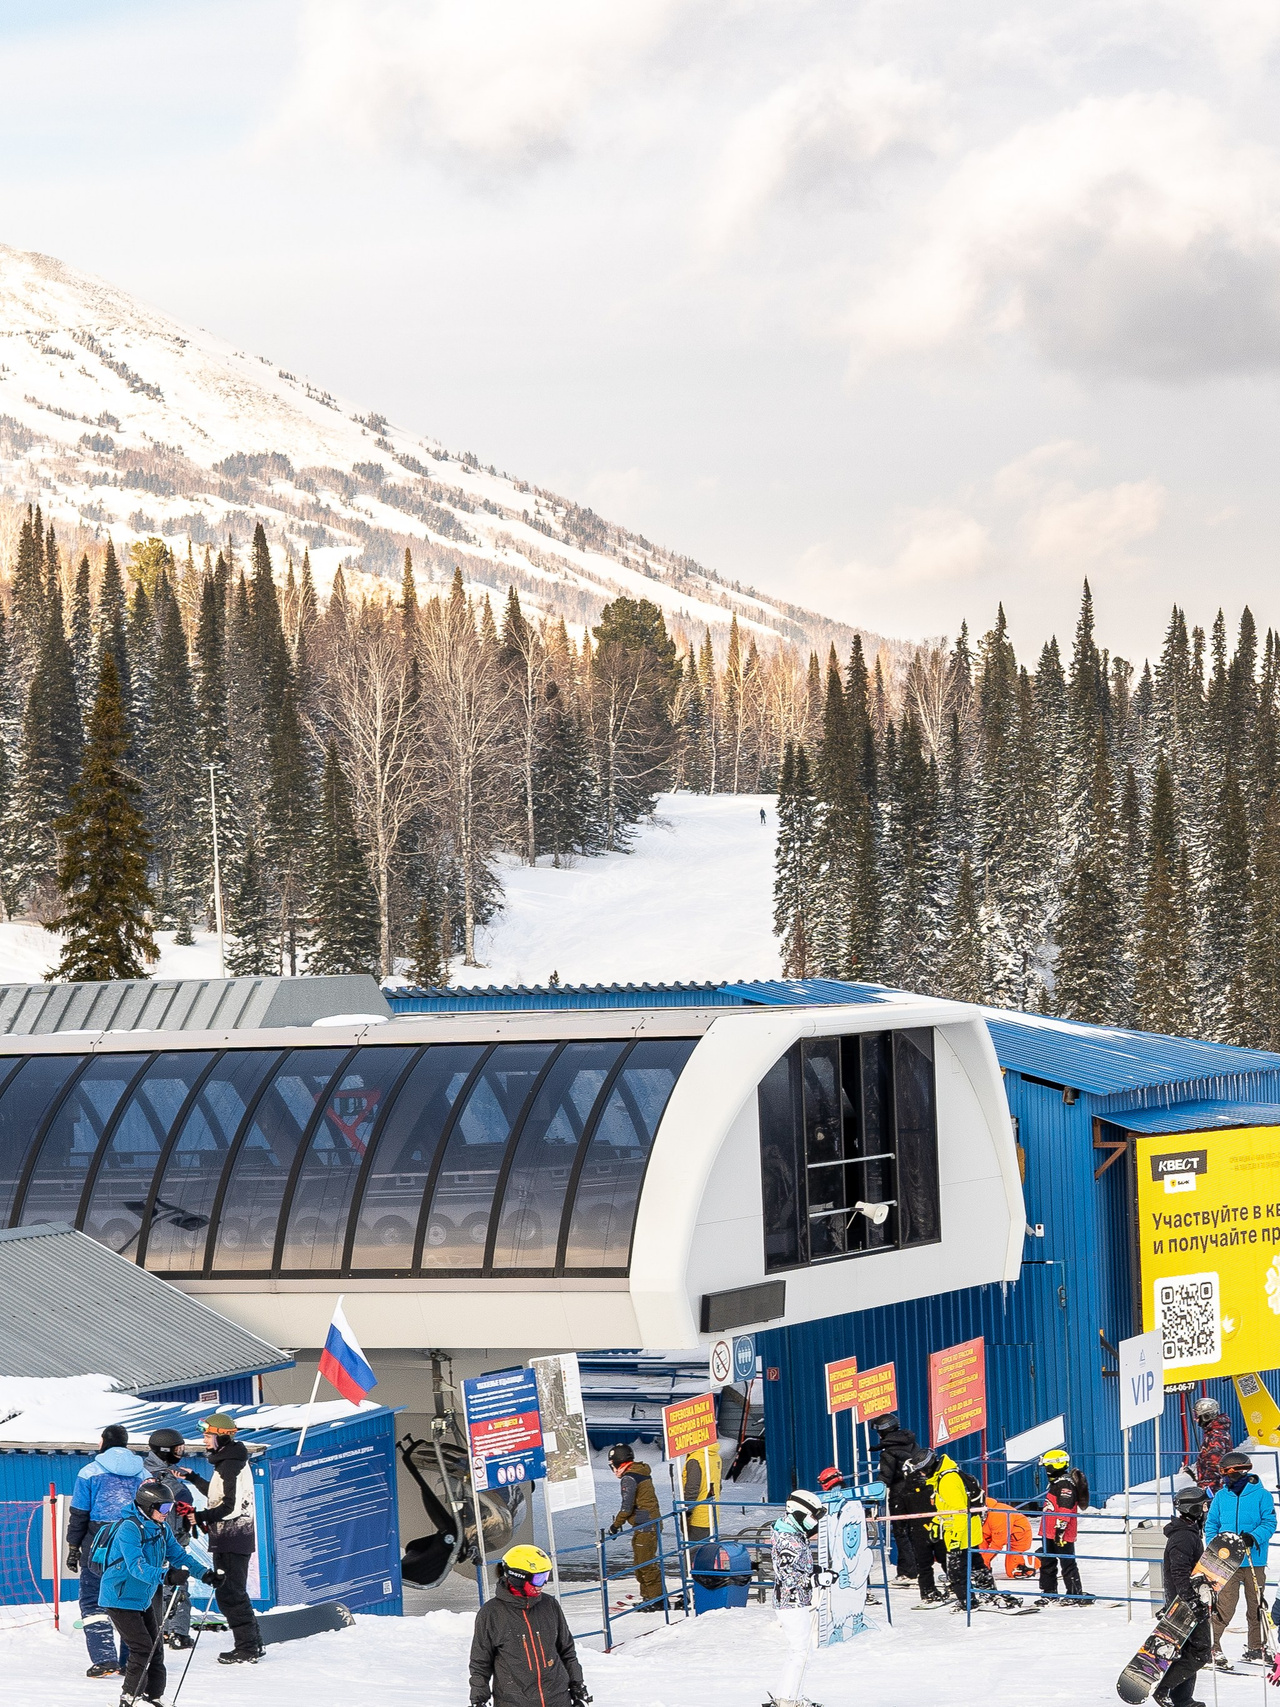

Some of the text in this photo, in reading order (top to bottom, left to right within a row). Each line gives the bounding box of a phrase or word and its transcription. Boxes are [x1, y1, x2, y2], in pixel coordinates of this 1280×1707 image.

[1158, 1158, 1199, 1172] КВЕСТ
[1152, 1204, 1249, 1230] Участвуйте
[1253, 1206, 1262, 1219] в
[1154, 1240, 1164, 1255] и
[1168, 1228, 1257, 1254] получайте
[1132, 1370, 1154, 1406] VIP
[670, 1406, 694, 1422] ПЕРЕВОЗКА
[694, 1402, 706, 1413] ЛЫЖ
[674, 1427, 709, 1450] ЗАПРЕЩЕНА
[508, 1570, 526, 1579] SMITH
